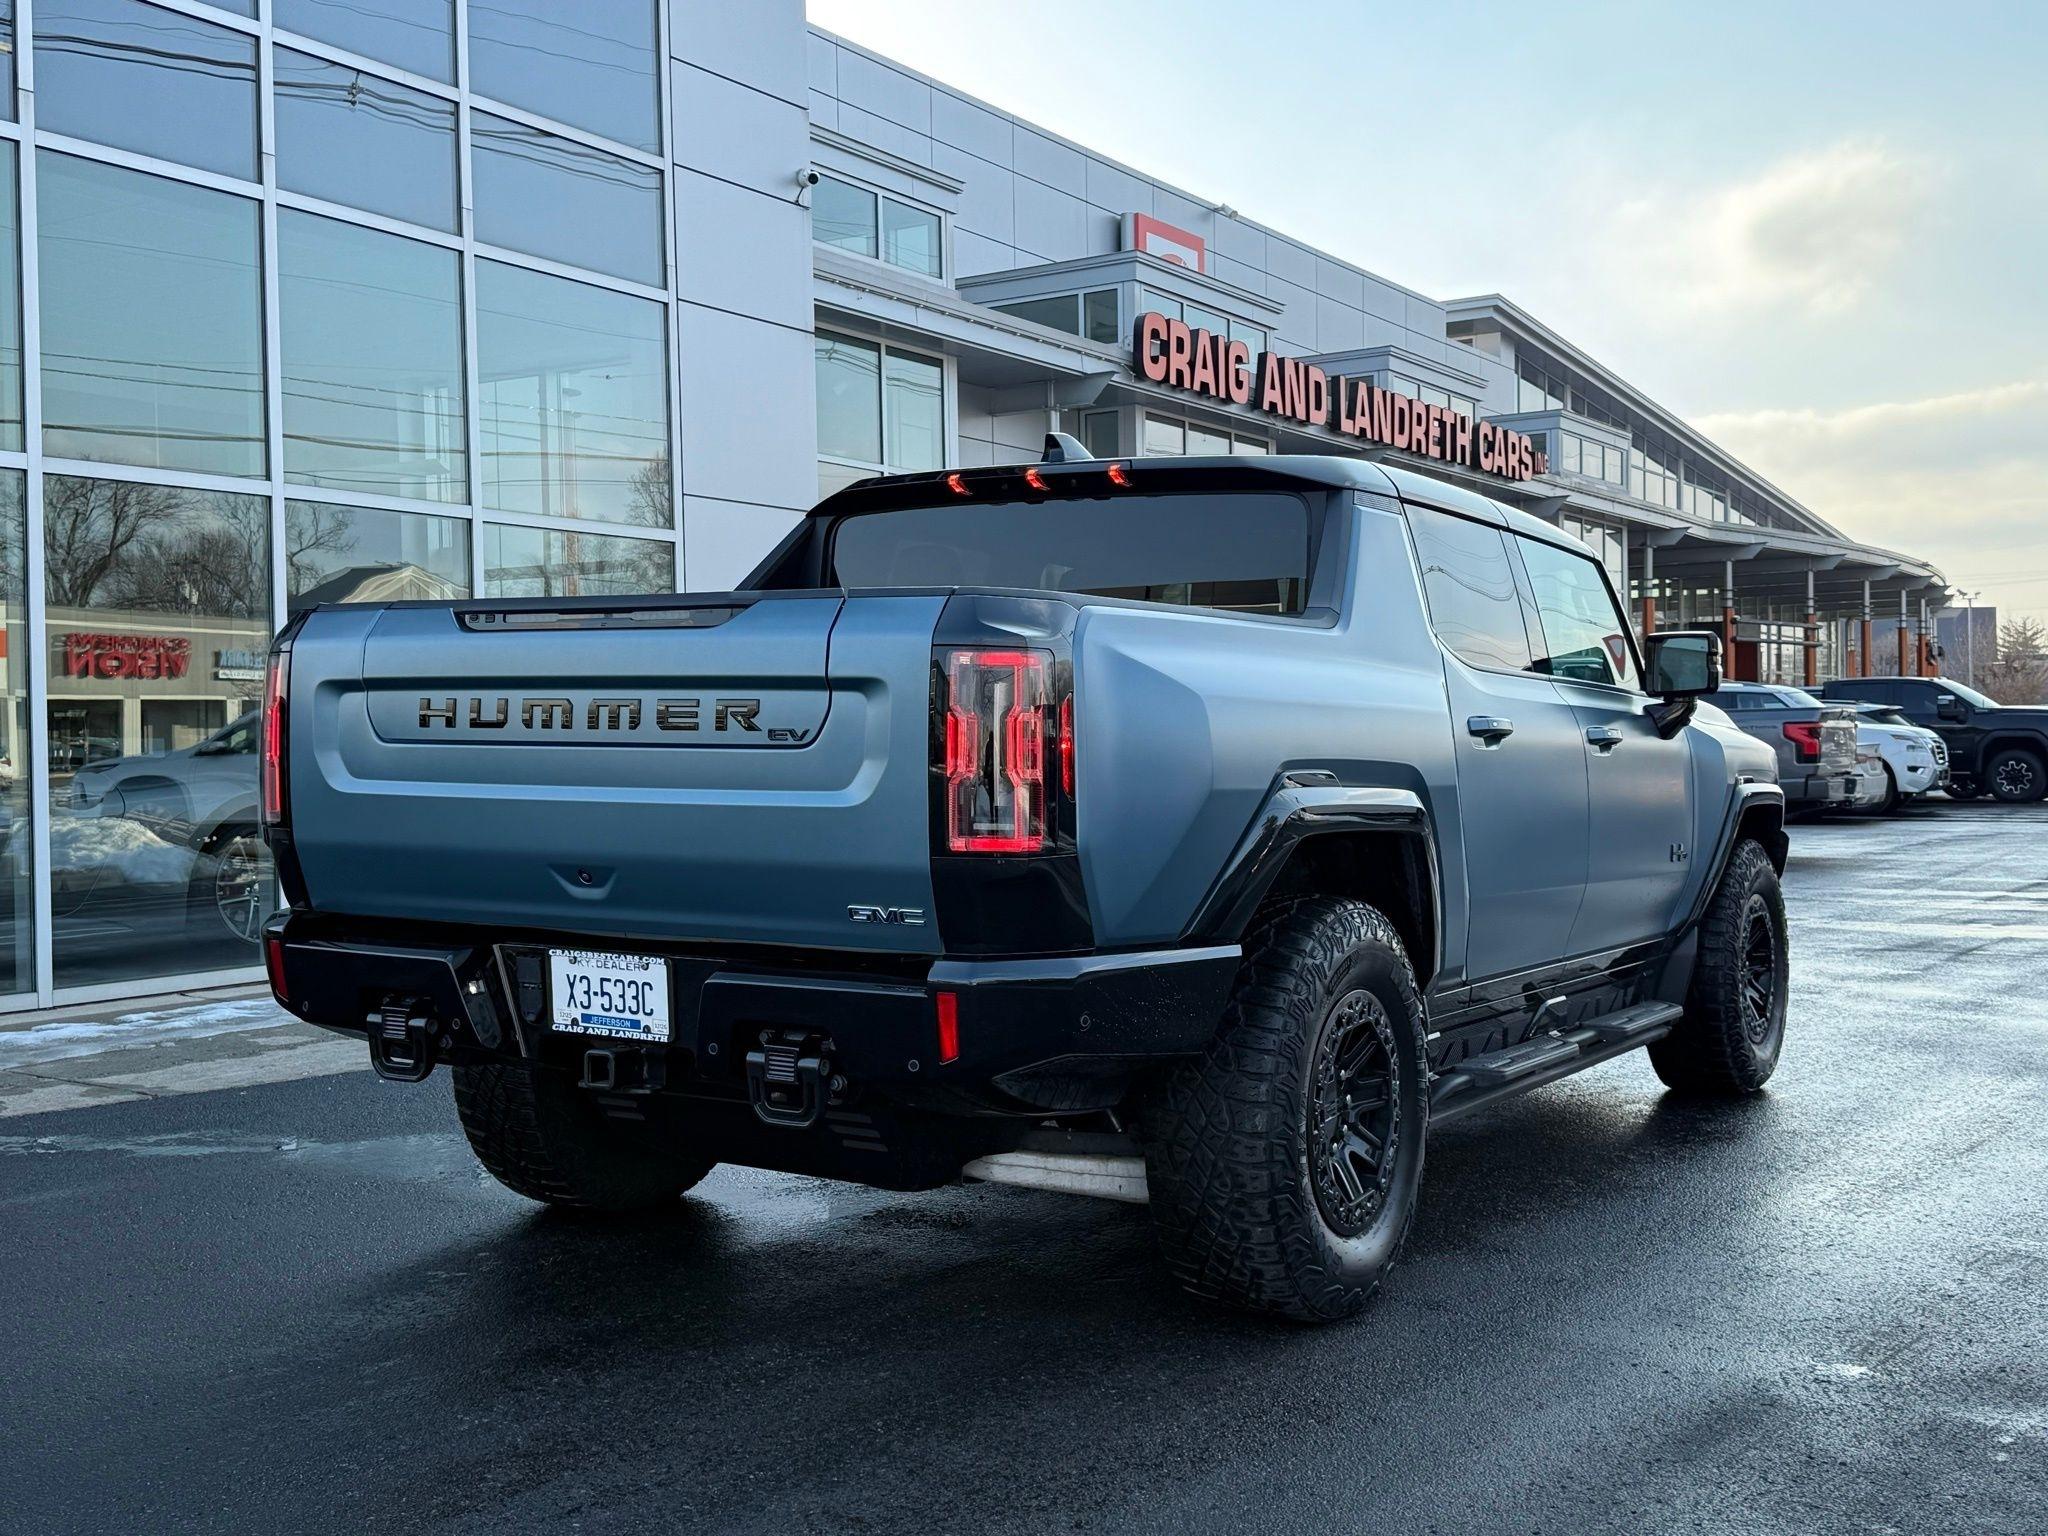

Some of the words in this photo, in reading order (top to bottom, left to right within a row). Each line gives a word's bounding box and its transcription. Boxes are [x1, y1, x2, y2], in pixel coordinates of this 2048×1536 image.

[1140, 311, 1250, 405] CRAIG
[1261, 351, 1328, 426] AND
[1338, 375, 1472, 467] LANDRETH
[1478, 419, 1533, 482] CARS
[418, 697, 763, 732] HUMMER
[767, 727, 810, 742] EV
[847, 904, 927, 926] GMC
[549, 949, 665, 965] CRAIGSBESTCARS.COM
[566, 973, 654, 1016] X3-533C
[552, 1024, 584, 1034] CRAIG
[586, 1028, 610, 1036] AND
[612, 1030, 668, 1042] LANDRETH
[590, 1016, 631, 1028] JEFFERSON
